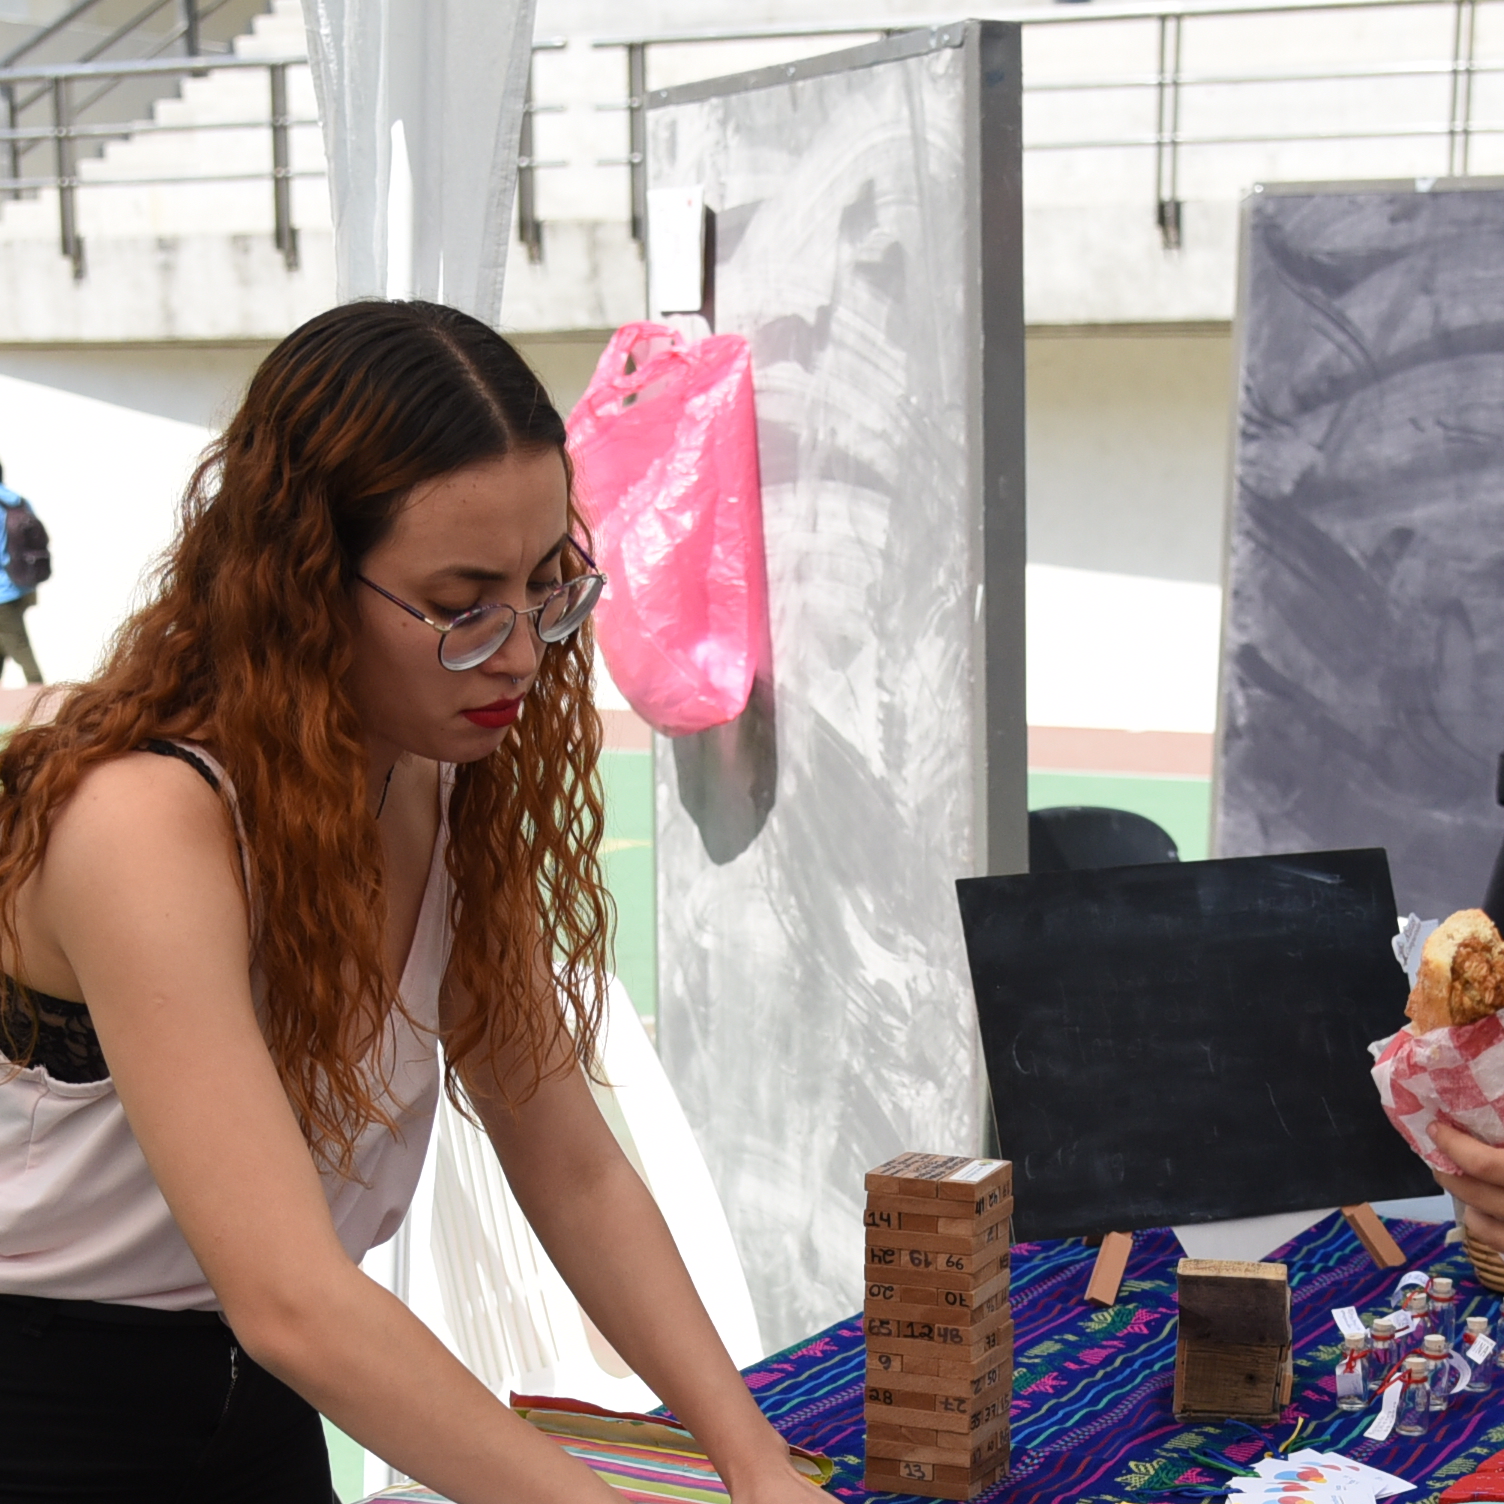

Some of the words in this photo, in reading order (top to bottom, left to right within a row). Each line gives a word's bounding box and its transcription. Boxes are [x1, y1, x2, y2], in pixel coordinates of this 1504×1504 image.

[867, 1212, 891, 1227] 14
[904, 1323, 933, 1340] 12
[937, 1327, 963, 1344] 48
[869, 1388, 893, 1405] 28
[904, 1463, 925, 1480] 13
